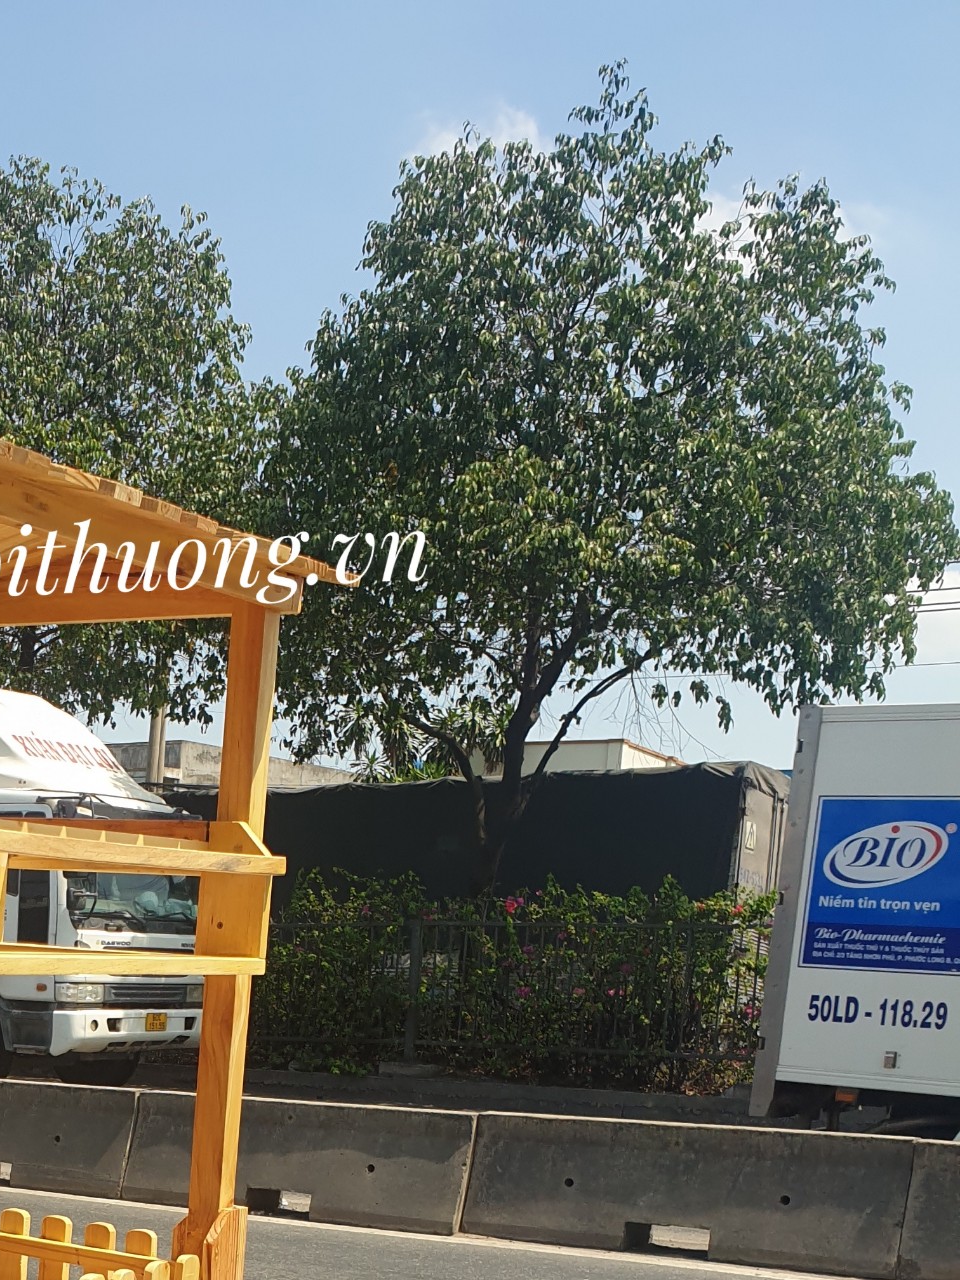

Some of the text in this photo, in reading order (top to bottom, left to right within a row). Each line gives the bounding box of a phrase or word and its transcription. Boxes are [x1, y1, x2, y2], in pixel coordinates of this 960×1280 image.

[843, 825, 927, 869] BIO
[858, 896, 877, 910] tin
[880, 898, 911, 913] trọn
[914, 901, 941, 914] vẹn
[807, 995, 859, 1024] 50LD
[879, 998, 948, 1030] 118.29
